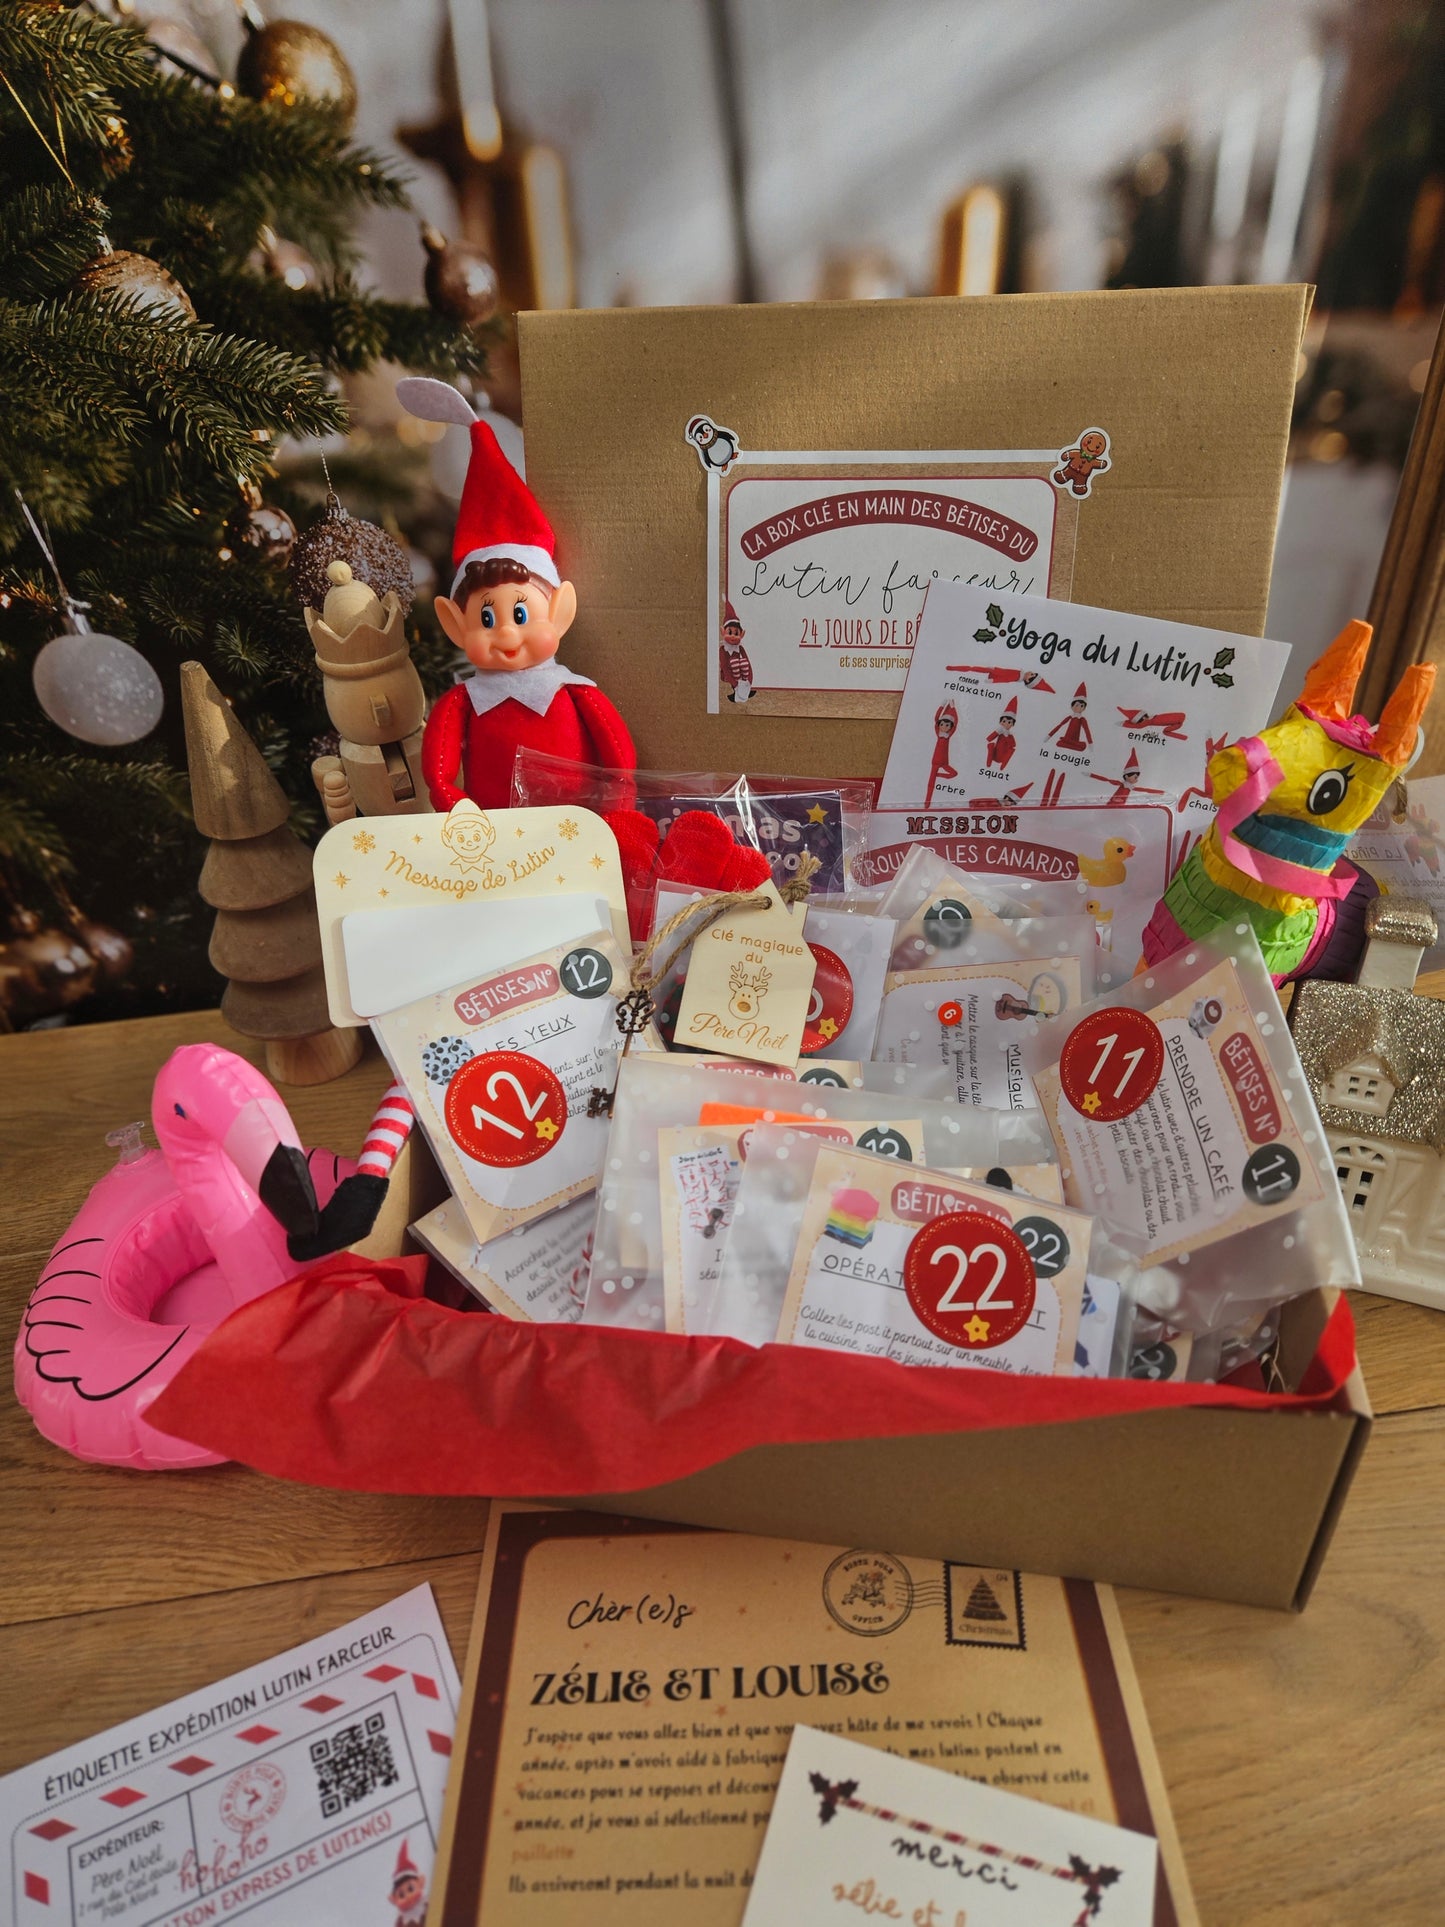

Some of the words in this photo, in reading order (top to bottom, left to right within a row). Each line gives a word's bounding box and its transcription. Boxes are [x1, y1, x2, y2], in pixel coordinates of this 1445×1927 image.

[745, 534, 767, 556] LA
[768, 514, 801, 543] BOX
[804, 500, 831, 528] CLÉ
[839, 499, 860, 519] EN
[865, 497, 905, 516] MAIN
[911, 498, 942, 520] DES
[946, 505, 1007, 542] BÊTISES
[1010, 531, 1034, 557] DU
[741, 560, 871, 605] Lutin
[800, 618, 819, 645] 24
[823, 618, 873, 647] JOURS
[880, 618, 897, 646] DE
[839, 655, 851, 669] et
[852, 657, 868, 669] ses
[1007, 617, 1071, 665] Yoga
[1083, 635, 1120, 667] du
[1127, 641, 1202, 688] Lutin
[944, 682, 1002, 700] relaxation
[1127, 731, 1167, 747] enfant
[979, 768, 1010, 780] squat
[1040, 748, 1049, 758] la
[1054, 752, 1091, 767] bougie
[935, 783, 965, 796] arbre
[906, 814, 1020, 835] MISSION
[386, 850, 478, 900] Message
[482, 869, 507, 890] de
[506, 845, 556, 881] Lutin
[945, 844, 979, 864] LES
[985, 846, 1075, 880] CANARDS
[711, 928, 734, 942] Clé
[740, 934, 804, 957] magique
[744, 952, 764, 965] du
[458, 976, 533, 1020] BÊTISES
[565, 954, 608, 992] 12
[524, 1014, 575, 1042] YEUX
[689, 1012, 735, 1041] Père
[736, 1020, 790, 1051] Noël
[944, 1008, 957, 1020] 6
[1010, 1044, 1024, 1110] Musique
[1087, 1032, 1146, 1099] 11
[471, 1070, 548, 1140] 12
[1168, 1034, 1203, 1109] PRENDRE
[1196, 1115, 1213, 1144] UN
[1207, 1150, 1235, 1197] CAFÉ
[1224, 1036, 1268, 1113] BÊTISES
[1251, 1154, 1293, 1199] 11
[1020, 1227, 1062, 1269] 22
[929, 1243, 1015, 1313] 22
[801, 1304, 836, 1326] Collez
[804, 1324, 818, 1340] la
[567, 1592, 694, 1630] Chèr(e)s
[530, 1661, 652, 1706] ZÉLIE
[663, 1667, 720, 1701] ET
[732, 1661, 890, 1700] LOUISE
[43, 1744, 144, 1802] ÉTIQUETTE
[149, 1691, 259, 1754] EXPÉDITION
[261, 1669, 312, 1704] LUTIN
[317, 1626, 396, 1676] FARCEUR
[588, 1731, 613, 1746] que
[617, 1729, 649, 1740] vous
[653, 1723, 688, 1740] allez
[692, 1722, 722, 1738] bien
[728, 1723, 740, 1737] et
[745, 1725, 771, 1740] que
[847, 1715, 879, 1732] hâte
[884, 1716, 900, 1731] de
[905, 1719, 925, 1731] me
[931, 1714, 973, 1730] revoir
[987, 1710, 1043, 1731] Chaque
[575, 1756, 614, 1774] après
[677, 1750, 707, 1767] aidé
[712, 1751, 721, 1766] à
[909, 1746, 936, 1758] mes
[939, 1742, 981, 1758] lutins
[1047, 1744, 1063, 1755] en
[517, 1783, 585, 1800] vacances
[590, 1786, 624, 1802] pour
[629, 1786, 643, 1798] se
[649, 1785, 702, 1802] reposer
[708, 1781, 721, 1796] et
[570, 1814, 584, 1830] et
[585, 1813, 602, 1834] je
[607, 1816, 640, 1829] vous
[644, 1812, 658, 1827] ai
[664, 1809, 748, 1827] sélectionné
[78, 1819, 166, 1870] EXPÉDITEUR:
[220, 1863, 293, 1910] EXPRESS
[296, 1848, 320, 1872] DE
[322, 1809, 393, 1857] LUTIN(S)
[891, 1837, 1019, 1892] merci
[531, 1875, 611, 1893] arriveront
[615, 1872, 680, 1895] pendant
[684, 1871, 700, 1890] la
[704, 1872, 736, 1889] nuit
